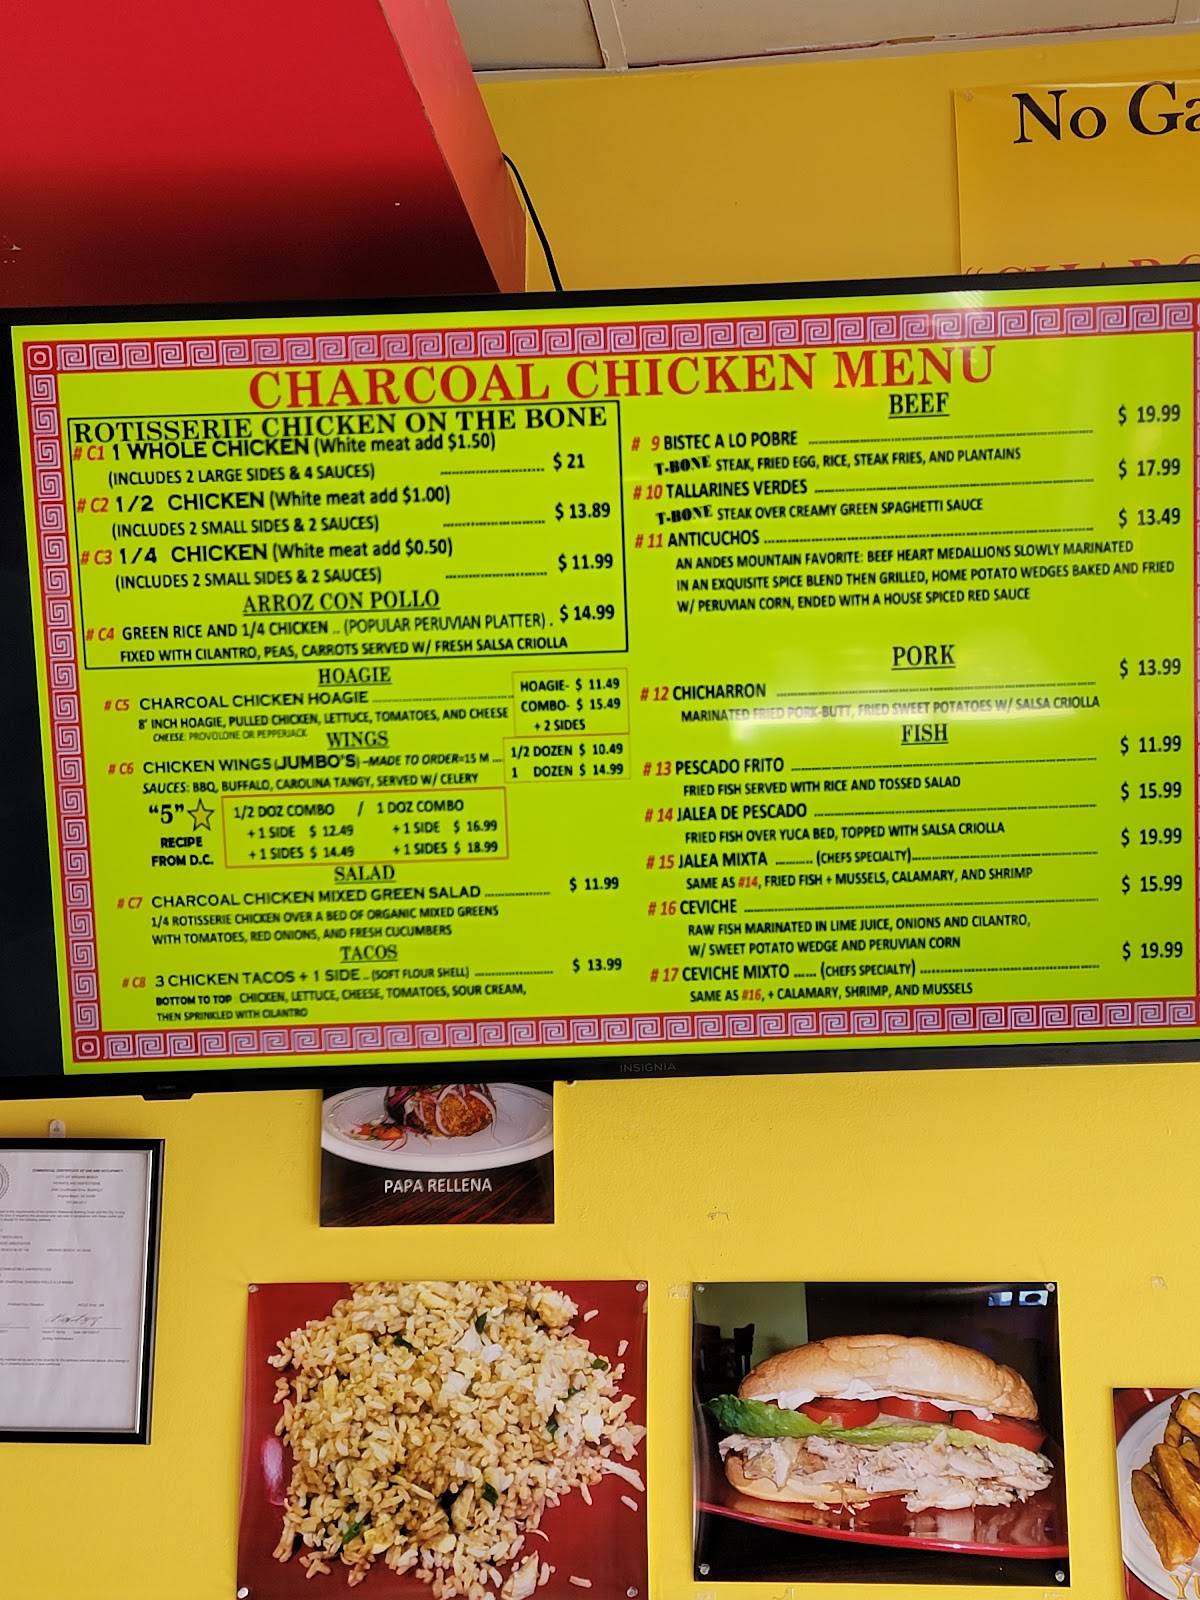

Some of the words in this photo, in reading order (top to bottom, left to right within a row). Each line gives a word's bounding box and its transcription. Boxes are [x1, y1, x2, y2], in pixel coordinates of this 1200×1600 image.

[1012, 89, 1107, 144] No
[250, 364, 549, 409] CHARCOAL
[567, 353, 816, 398] CHICKEN
[834, 345, 994, 388] MENU
[888, 391, 949, 418] BEEF
[1118, 404, 1126, 425] $
[1137, 404, 1180, 422] 19.99
[74, 419, 252, 442] ROTISSERIE
[261, 413, 394, 437] CHICKEN
[405, 411, 446, 433] ON
[455, 409, 515, 431] THE
[525, 406, 606, 429] BONE
[112, 443, 119, 460] 1
[126, 440, 207, 460] WHOLE
[212, 437, 309, 457] CHICKEN
[314, 436, 366, 457] (White
[371, 436, 410, 451] meat
[415, 434, 443, 450] add
[448, 433, 495, 452] $1.50)
[663, 433, 710, 450] BISTEC
[714, 433, 724, 448] A
[728, 432, 746, 448] LO
[750, 430, 797, 447] POBRE
[553, 452, 562, 471] $
[567, 453, 584, 468] 21
[716, 457, 753, 472] STEAK,
[757, 456, 789, 469] FRIED
[793, 455, 819, 469] EGG,
[823, 454, 850, 469] RICE,
[853, 452, 888, 466] STEAK
[892, 451, 925, 465] FRIES,
[929, 450, 954, 463] AND
[957, 447, 1020, 461] PLANTAINS
[1118, 458, 1127, 480] $
[1137, 458, 1180, 476] 17.99
[108, 469, 181, 488] (INCLUDES
[186, 469, 194, 483] 2
[198, 468, 242, 483] LARGE
[246, 466, 285, 481] SIDES
[289, 465, 300, 480] &
[304, 466, 312, 479] 4
[316, 462, 374, 481] SAUCES)
[116, 495, 153, 512] 1/2
[168, 491, 264, 510] CHICKEN
[269, 489, 321, 510] (White
[326, 489, 365, 505] meat
[370, 487, 397, 504] add
[402, 485, 450, 506] $1.00)
[665, 480, 749, 499] TALLARINES
[753, 478, 807, 495] VERDES
[555, 502, 564, 521] $
[569, 502, 610, 519] 13.89
[1118, 507, 1127, 528] $
[1137, 507, 1180, 525] 13.49
[667, 529, 759, 547] ANTICUCHOS
[558, 553, 567, 572] $
[572, 553, 613, 569] 11.99
[675, 557, 692, 569] AN
[695, 555, 733, 569] ANDES
[736, 553, 801, 567] MOUNTAIN
[867, 549, 893, 562] BEEF
[897, 548, 934, 561] HEART
[937, 545, 1010, 560] MEDALLIONS
[1014, 543, 1059, 557] SLOWLY
[1063, 540, 1133, 554] MARINATED
[243, 593, 314, 613] ARROZ
[319, 592, 362, 611] CON
[370, 590, 439, 609] POLLO
[559, 604, 568, 623] $
[573, 604, 614, 620] 14.99
[891, 644, 955, 670] PORK
[318, 666, 391, 687] HOAGIE
[1120, 658, 1128, 679] $
[1138, 658, 1180, 675] 13.99
[575, 677, 582, 691] $
[589, 677, 619, 690] 11.49
[672, 682, 765, 700] CHICHARRON
[139, 695, 228, 710] CHARCOAL
[232, 692, 303, 707] CHICKEN
[308, 690, 368, 704] HOAGIE
[326, 730, 388, 750] WINGS
[901, 723, 948, 745] FISH
[511, 745, 529, 759] 1/2
[533, 744, 572, 757] DOZEN
[579, 743, 585, 756] $
[593, 742, 623, 755] 10.49
[1120, 735, 1128, 756] $
[1139, 735, 1181, 752] 11.99
[675, 758, 739, 775] PESCADO
[744, 757, 784, 773] FRITO
[677, 806, 717, 821] JALEA
[721, 805, 738, 820] DE
[743, 802, 807, 819] PESCADO
[160, 835, 202, 848] RECIPE
[151, 854, 186, 867] FROM
[189, 853, 213, 865] D.C.
[334, 865, 396, 883] SALAD
[569, 877, 576, 892] $
[585, 876, 618, 890] 11.99
[151, 893, 240, 908] CHARCOAL
[243, 890, 313, 905] CHICKEN
[318, 889, 366, 902] MIXED
[370, 887, 424, 901] GREEN
[428, 885, 480, 899] SALAD
[340, 944, 397, 963] TACOS
[1122, 940, 1130, 961] $
[1141, 941, 1182, 958] 19.99
[682, 965, 739, 981] CEVICHE
[743, 963, 789, 979] MIXTO
[820, 960, 856, 980] (CHEFS
[859, 958, 915, 979] SPECIALTY)
[690, 990, 721, 1002] SAME
[724, 989, 738, 1001] AS
[777, 986, 841, 1001] CALAMARY,
[845, 984, 891, 999] SHRIMP,
[894, 984, 919, 996] AND
[922, 982, 972, 995] MUSSELS
[620, 1063, 676, 1073] INSIGNIA
[384, 1178, 424, 1194] PAPA
[428, 1177, 492, 1193] RELLENA
